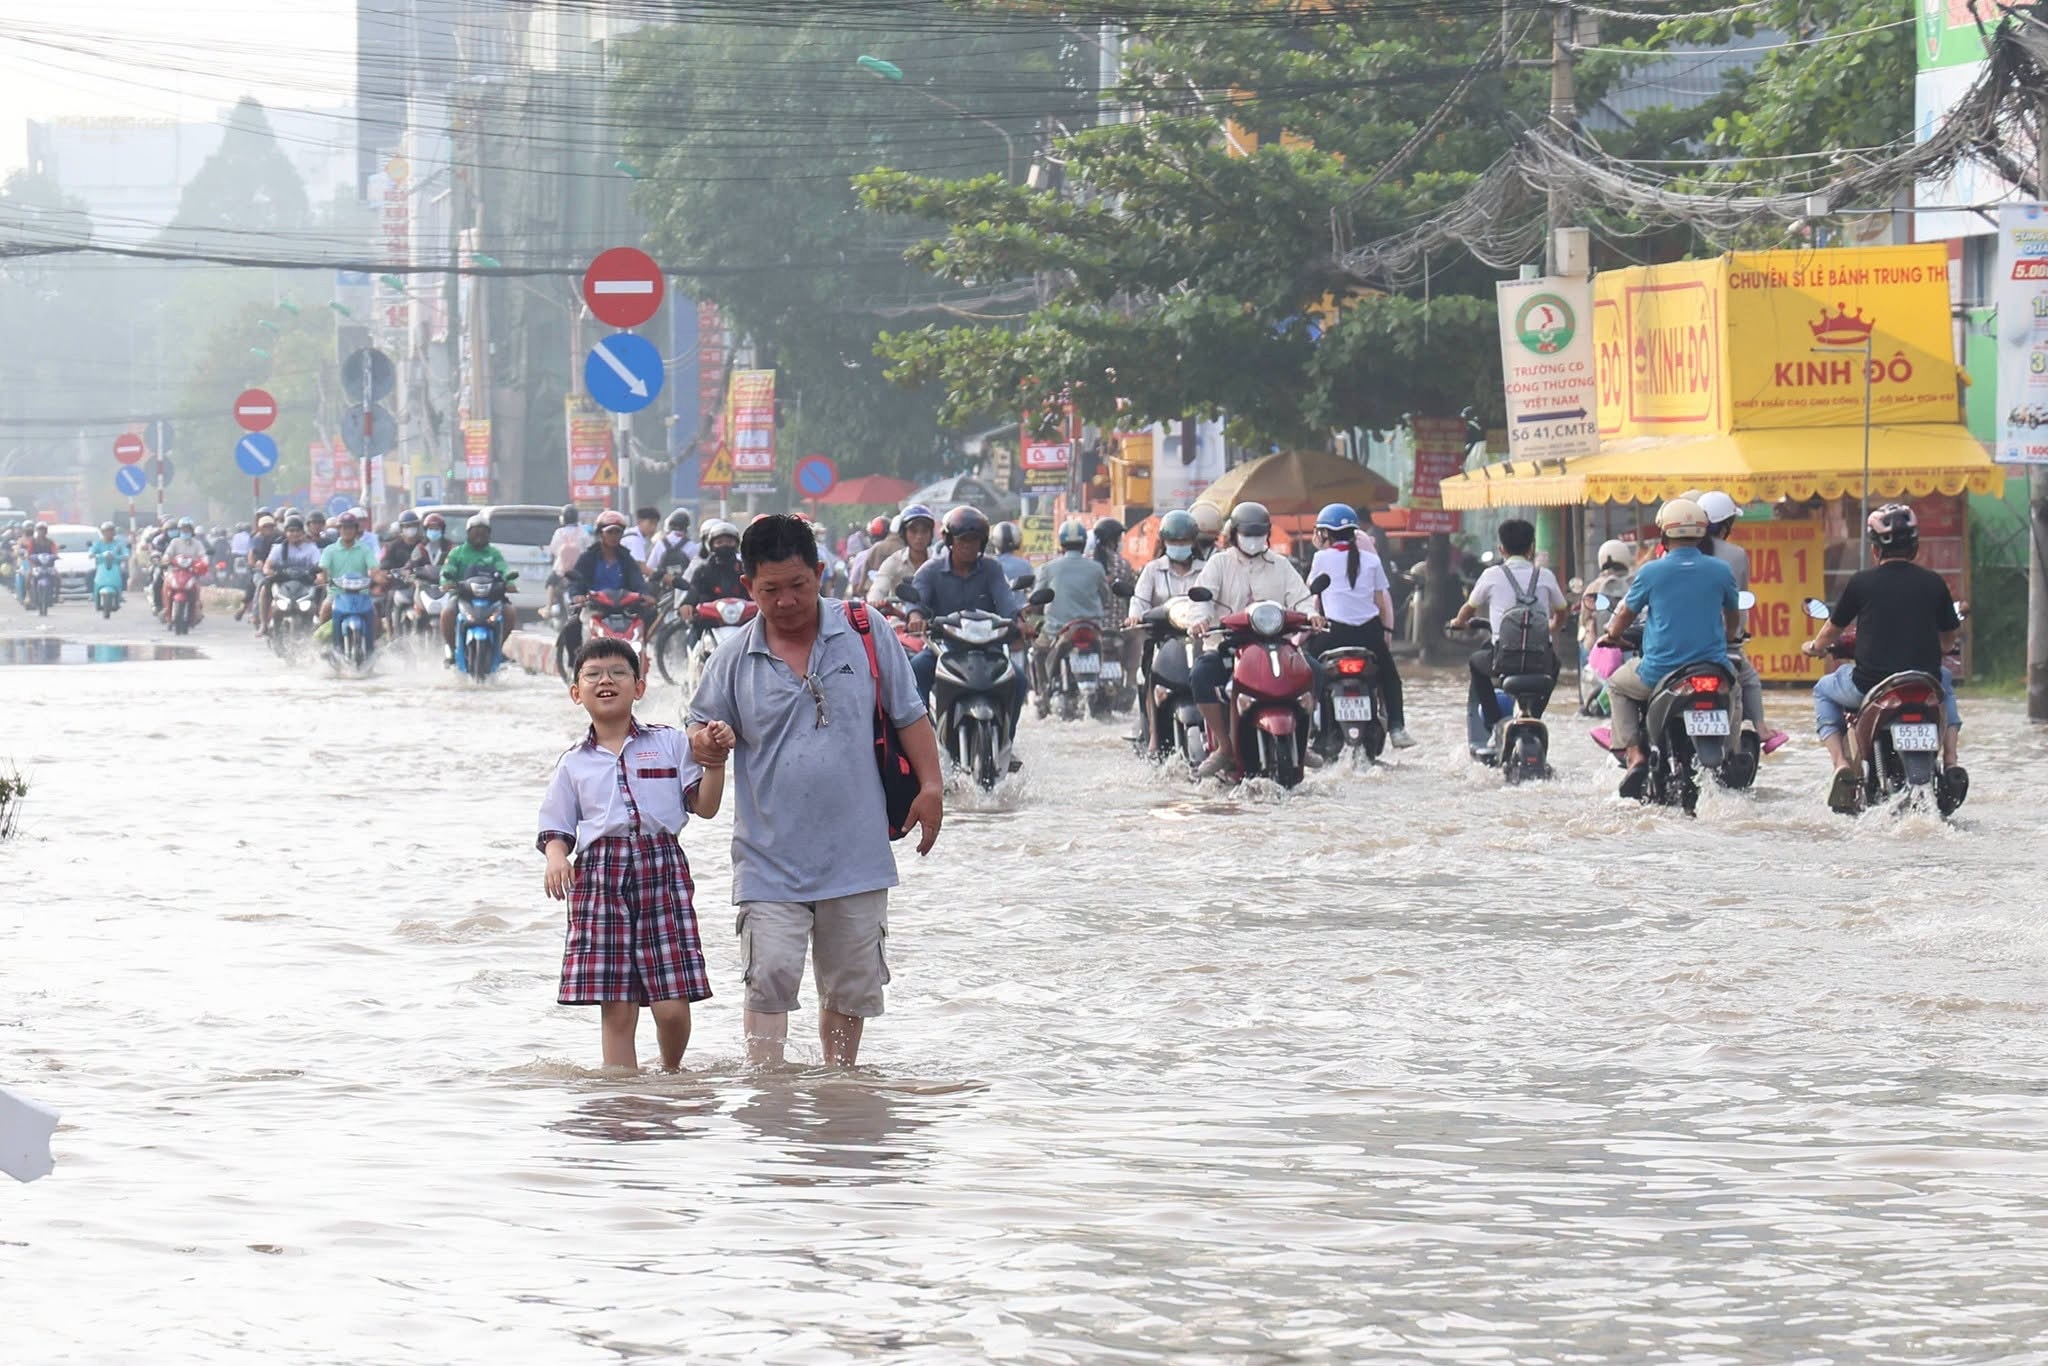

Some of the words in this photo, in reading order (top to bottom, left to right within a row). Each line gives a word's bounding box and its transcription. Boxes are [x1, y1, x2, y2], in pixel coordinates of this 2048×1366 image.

[1728, 267, 1788, 289] CHUYÊN
[1828, 264, 1869, 286] BÁNH
[1873, 266, 1923, 285] TRUNG
[1774, 360, 1851, 387] KINH
[1862, 351, 1913, 384] ĐÔ
[1552, 394, 1580, 406] NAM
[1793, 549, 1807, 584] 1
